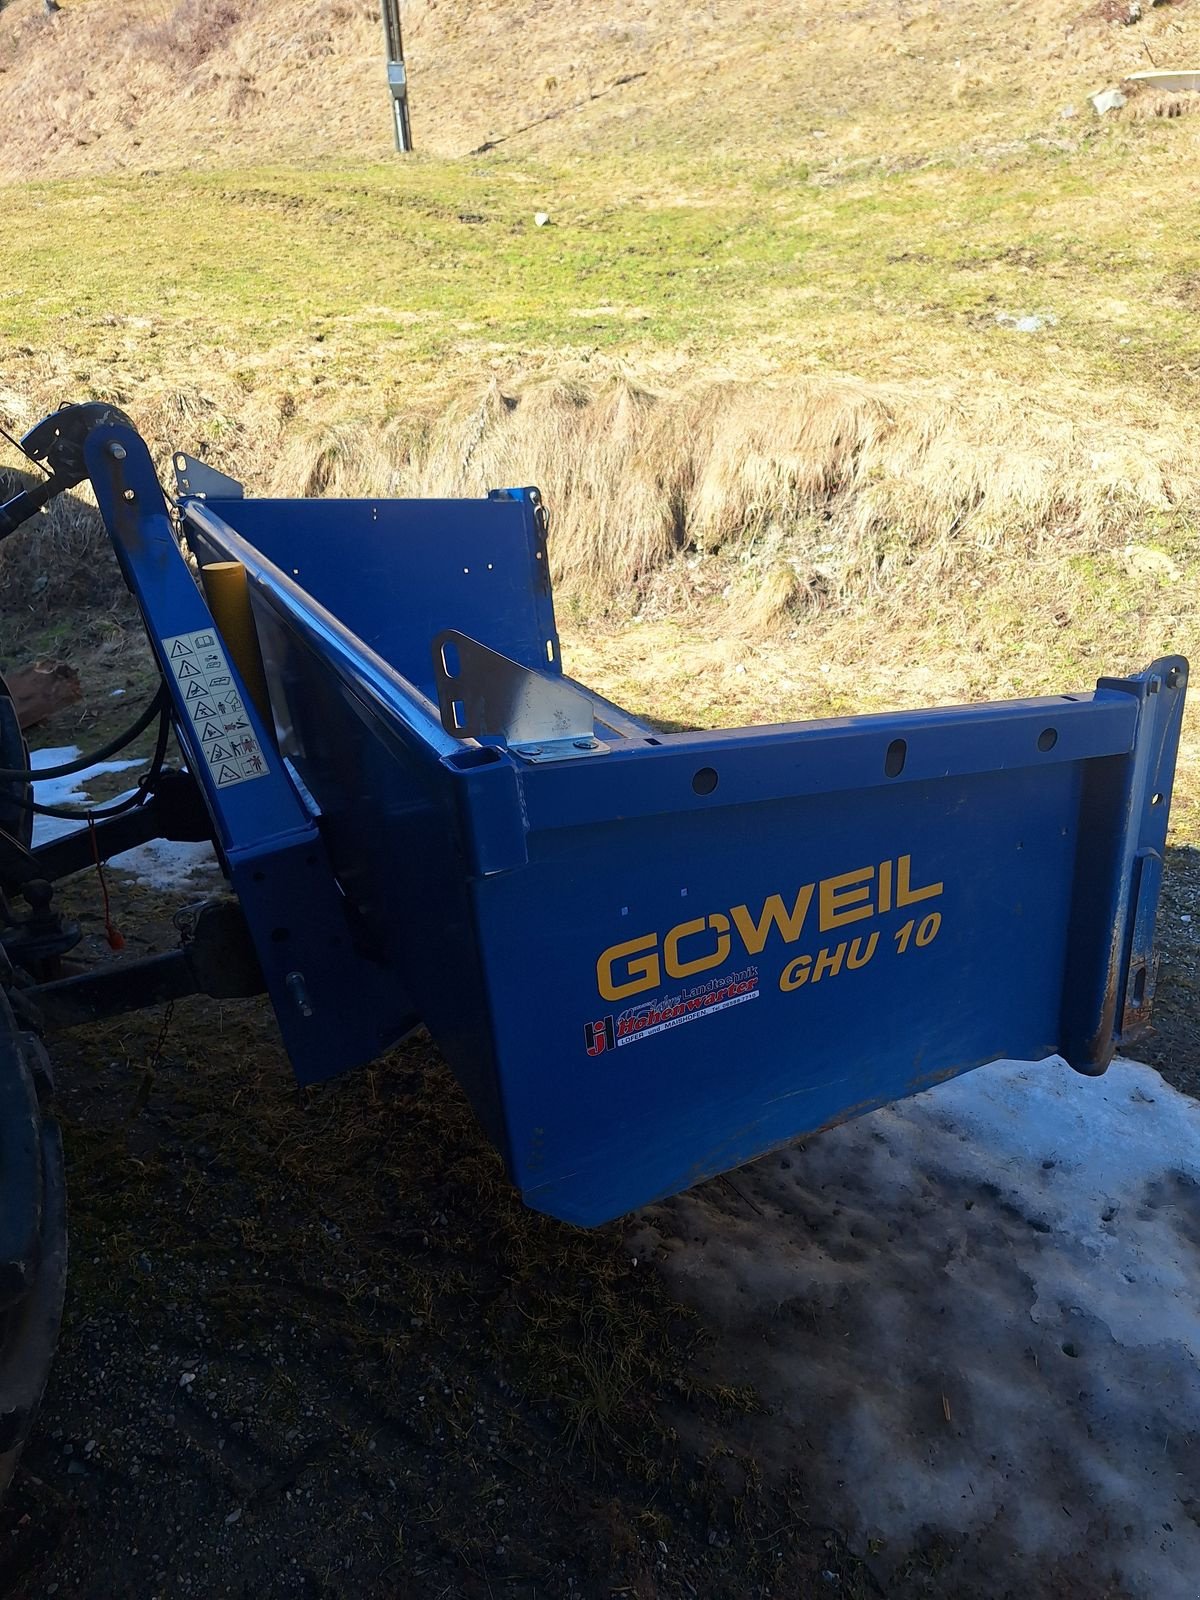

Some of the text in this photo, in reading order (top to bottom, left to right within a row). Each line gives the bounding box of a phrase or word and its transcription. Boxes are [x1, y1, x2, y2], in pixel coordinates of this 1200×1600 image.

[780, 912, 943, 993] GHU 10
[681, 966, 758, 1000] Landtechnik
[617, 977, 758, 1037] Hohenwarter
[621, 1032, 644, 1045] LOFER
[648, 1026, 661, 1036] und
